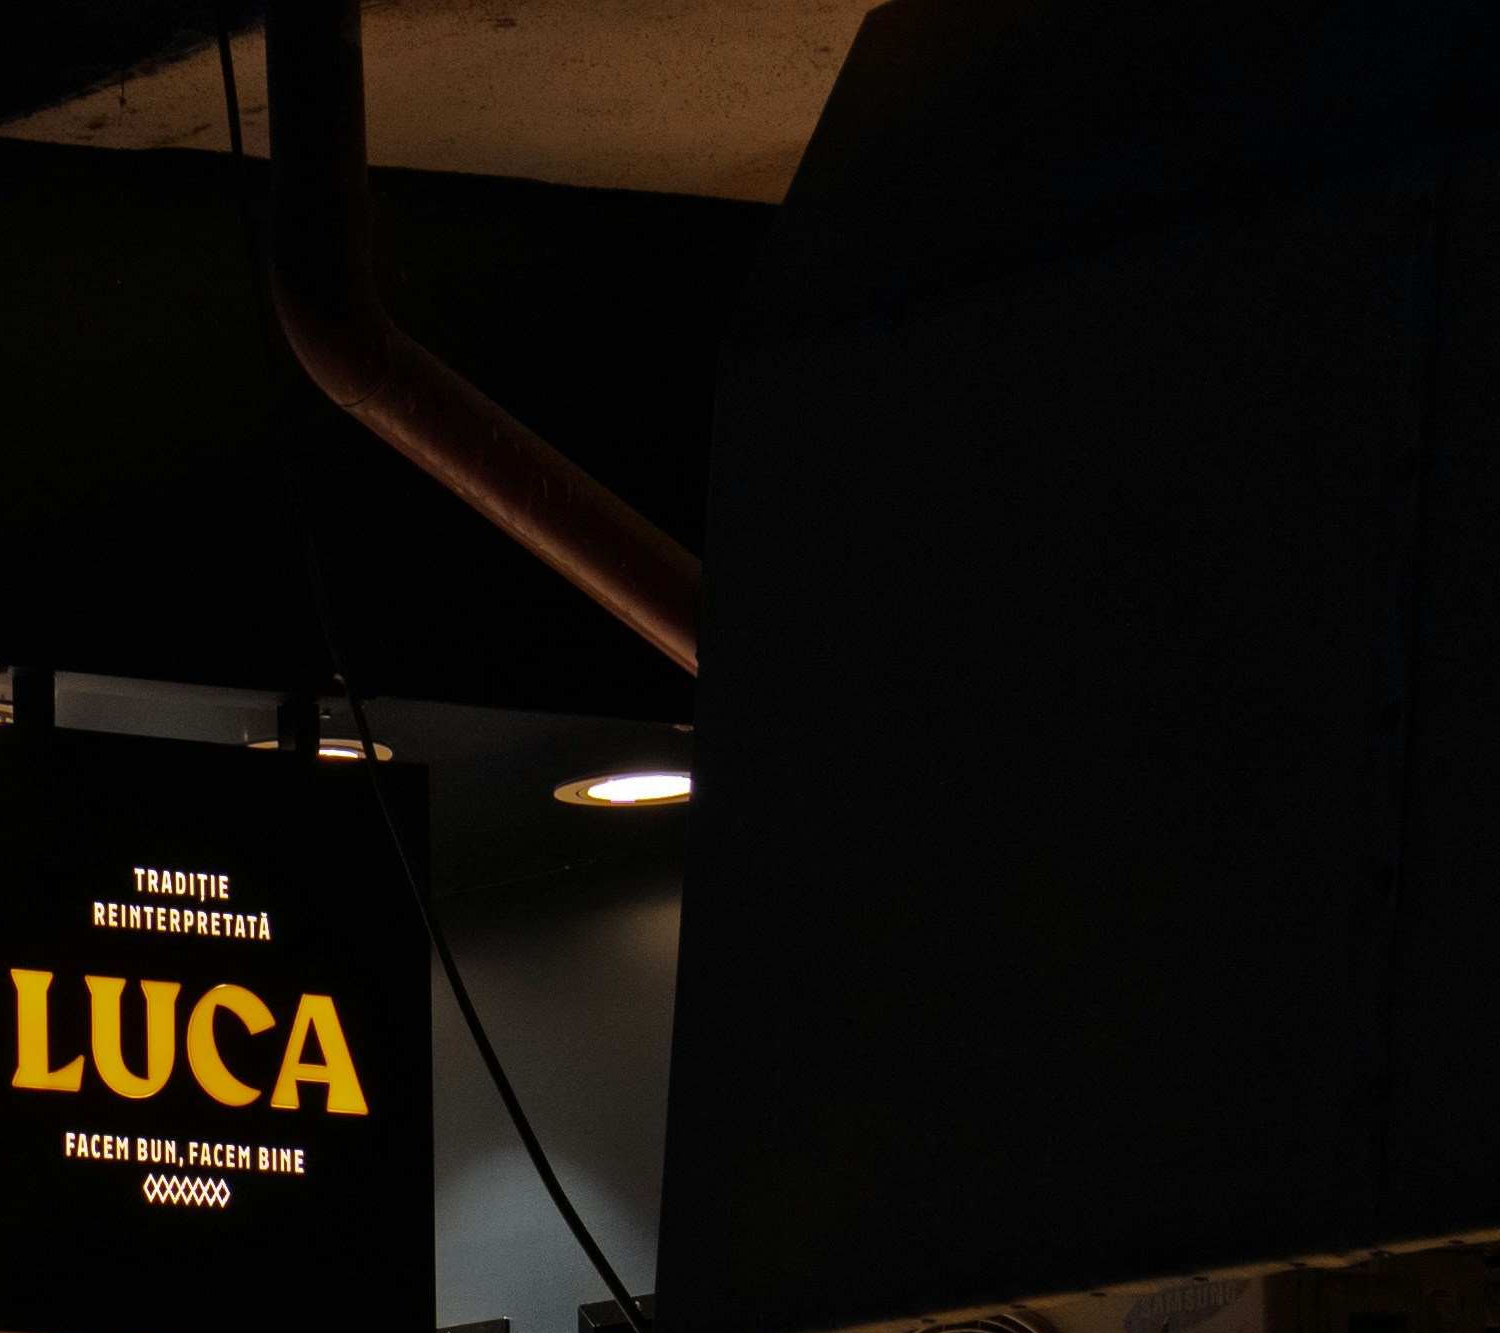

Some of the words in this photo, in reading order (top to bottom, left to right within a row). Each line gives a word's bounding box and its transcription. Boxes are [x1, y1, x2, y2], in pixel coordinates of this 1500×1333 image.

[134, 868, 230, 902] TRADIȚIE
[93, 902, 271, 940] REINTERPRETATĂ
[11, 969, 369, 1115] LUCA
[65, 1132, 130, 1161] FACEM
[137, 1138, 184, 1167] BUN,
[189, 1141, 252, 1170] FACEM
[258, 1147, 305, 1173] BINE
[1139, 1281, 1238, 1318] SAMSUNG
